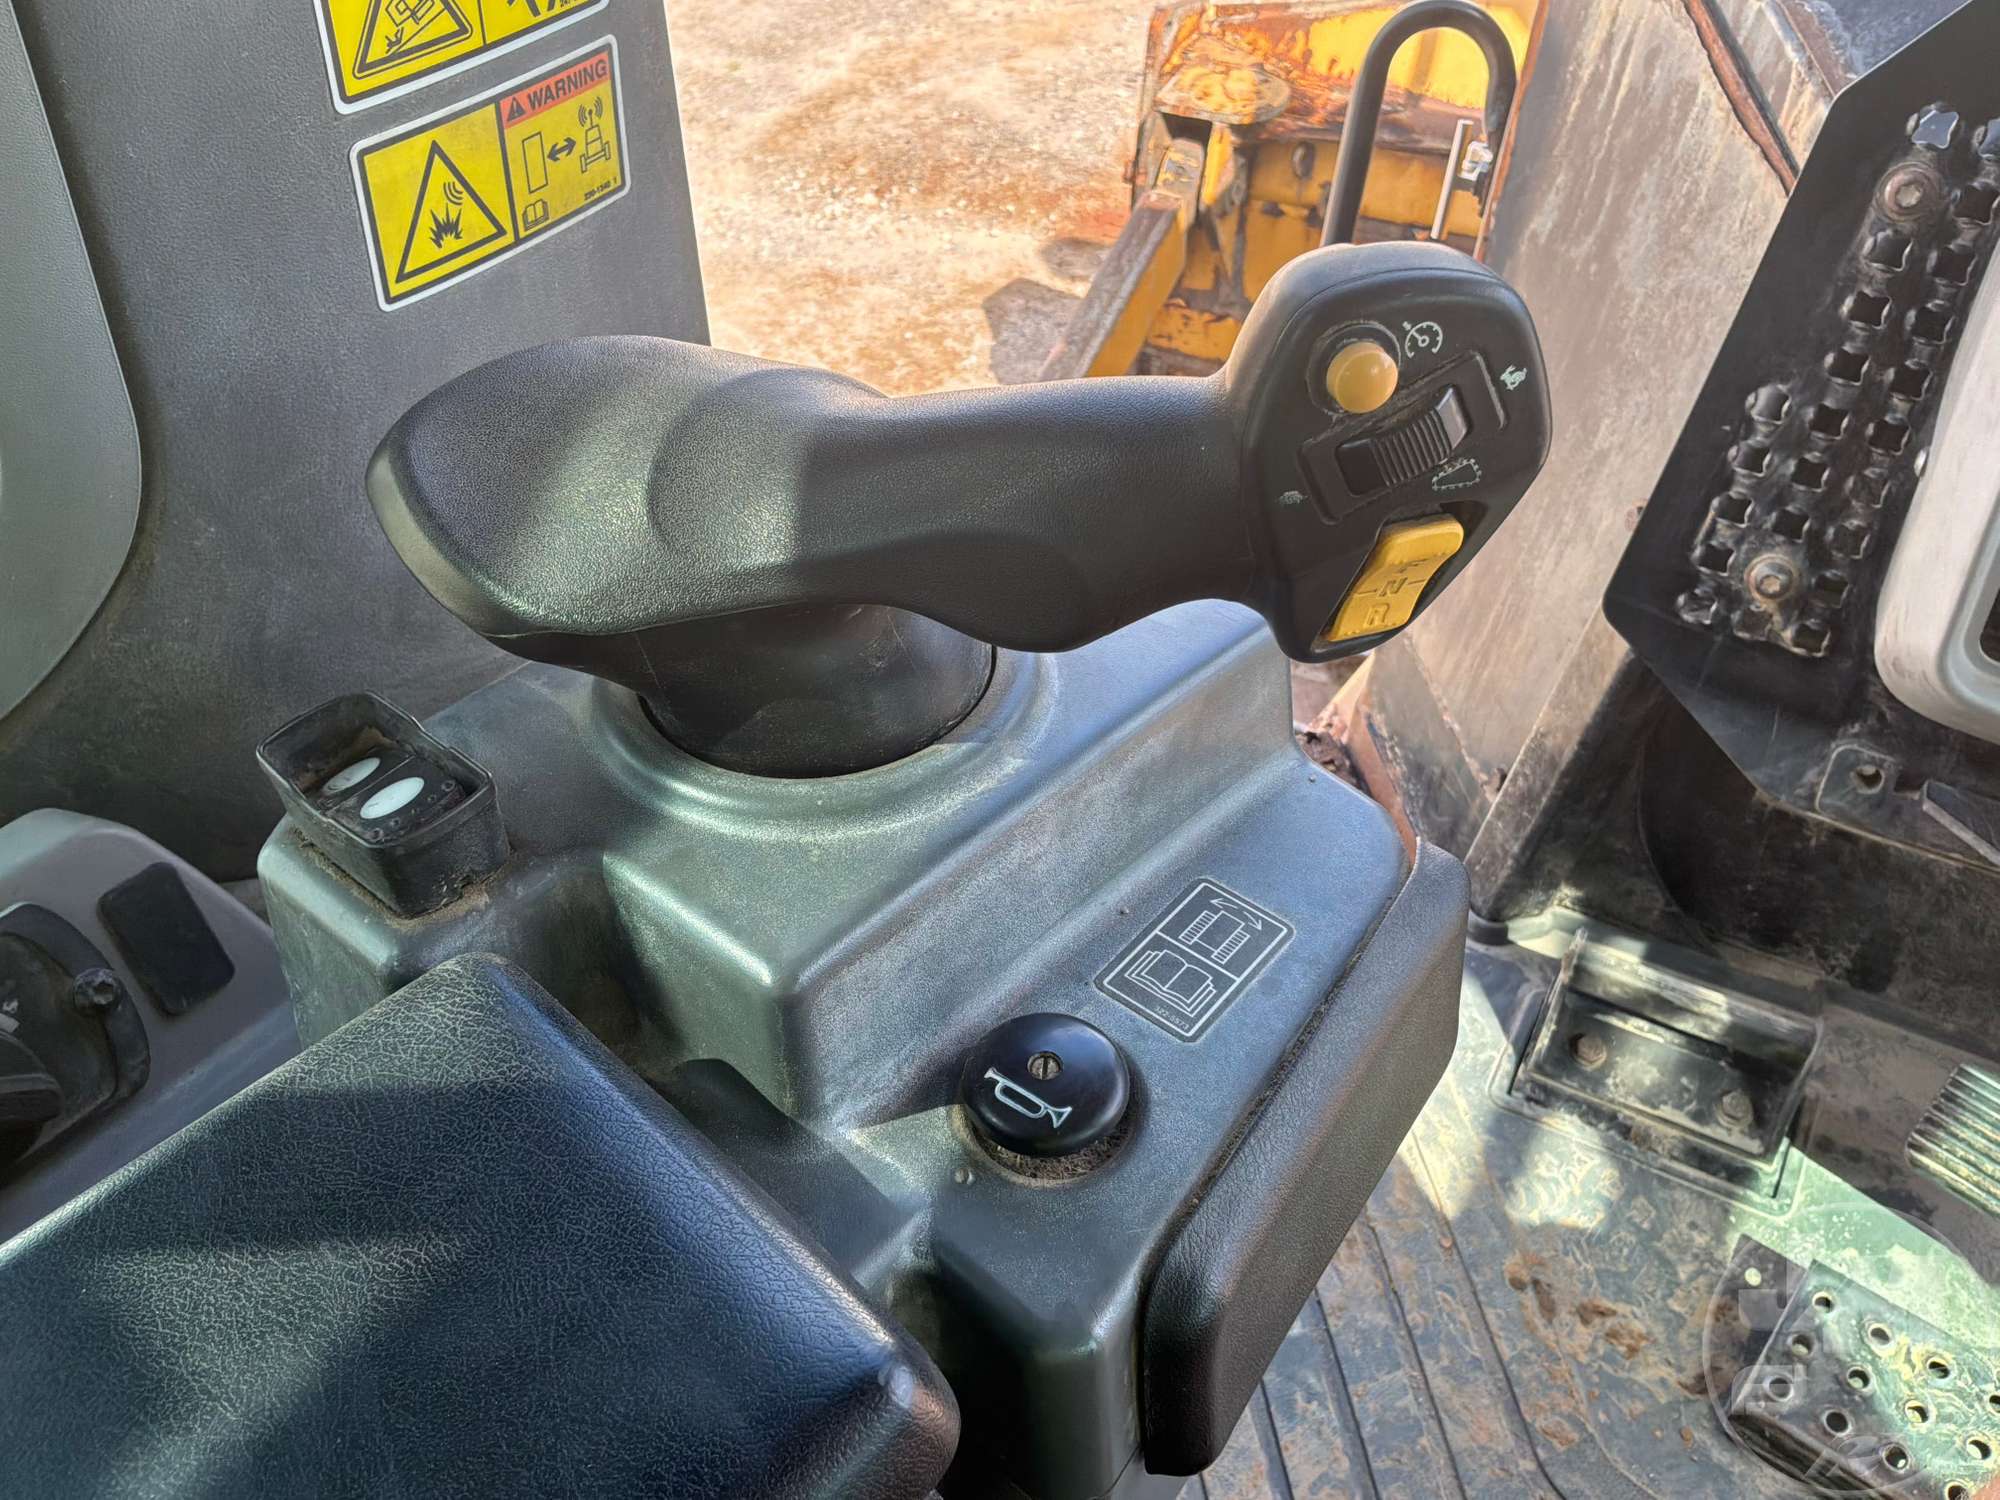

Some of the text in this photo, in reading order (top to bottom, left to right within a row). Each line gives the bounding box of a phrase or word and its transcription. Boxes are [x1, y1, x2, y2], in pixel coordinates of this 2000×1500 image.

[527, 59, 608, 111] WARNING
[1378, 577, 1408, 597] N
[1363, 602, 1390, 626] R
